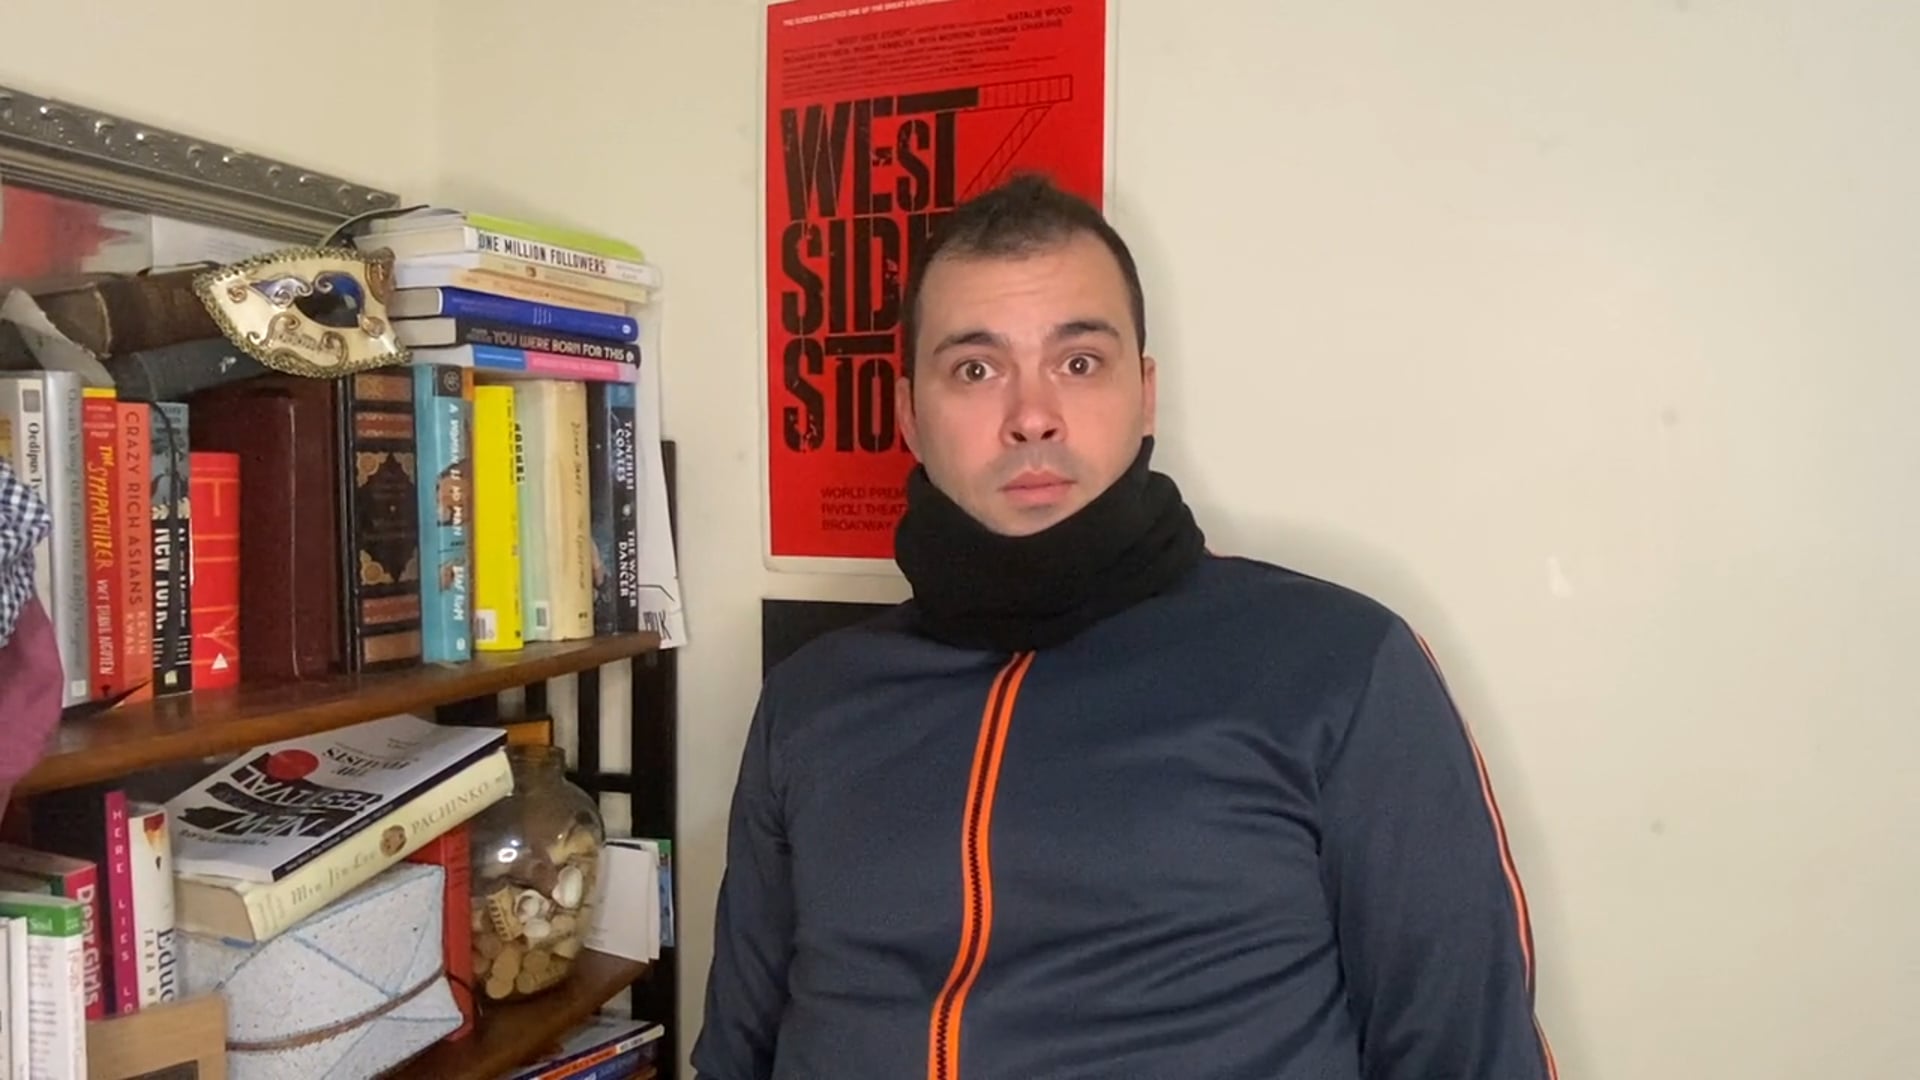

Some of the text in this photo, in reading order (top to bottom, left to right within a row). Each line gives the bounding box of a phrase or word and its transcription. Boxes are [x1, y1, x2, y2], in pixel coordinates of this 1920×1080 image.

[780, 86, 979, 220] WEST
[478, 232, 499, 252] ONE
[504, 239, 547, 263] MILLION
[551, 249, 607, 275] FOLLOWERS
[492, 330, 517, 346] YOU
[519, 336, 551, 351] WERE
[552, 339, 581, 356] BORN
[583, 344, 602, 359] FOR
[604, 347, 625, 361] THIS
[449, 403, 459, 413] A
[783, 334, 908, 453] STO
[26, 422, 41, 474] Oedipus
[98, 445, 115, 467] THE
[449, 419, 459, 464] WOMAN
[615, 427, 627, 482] COATES
[625, 420, 635, 491] TA-NEHISI
[87, 461, 114, 571] SYMPATHIZER
[125, 411, 143, 605] CRAZY RICH ASIANS
[452, 505, 463, 537] MAN
[618, 541, 630, 597] DANCER
[627, 529, 638, 608] THE WATER
[125, 612, 135, 656] KWAN
[137, 611, 148, 655] KEVIN
[216, 813, 326, 838] NEW
[411, 782, 490, 836] PACHINKO
[112, 809, 124, 874] HERE
[118, 898, 130, 962] LIES
[77, 884, 102, 1007] Dear Girls
[143, 928, 156, 974] TARA
[157, 927, 177, 1004] Educ
